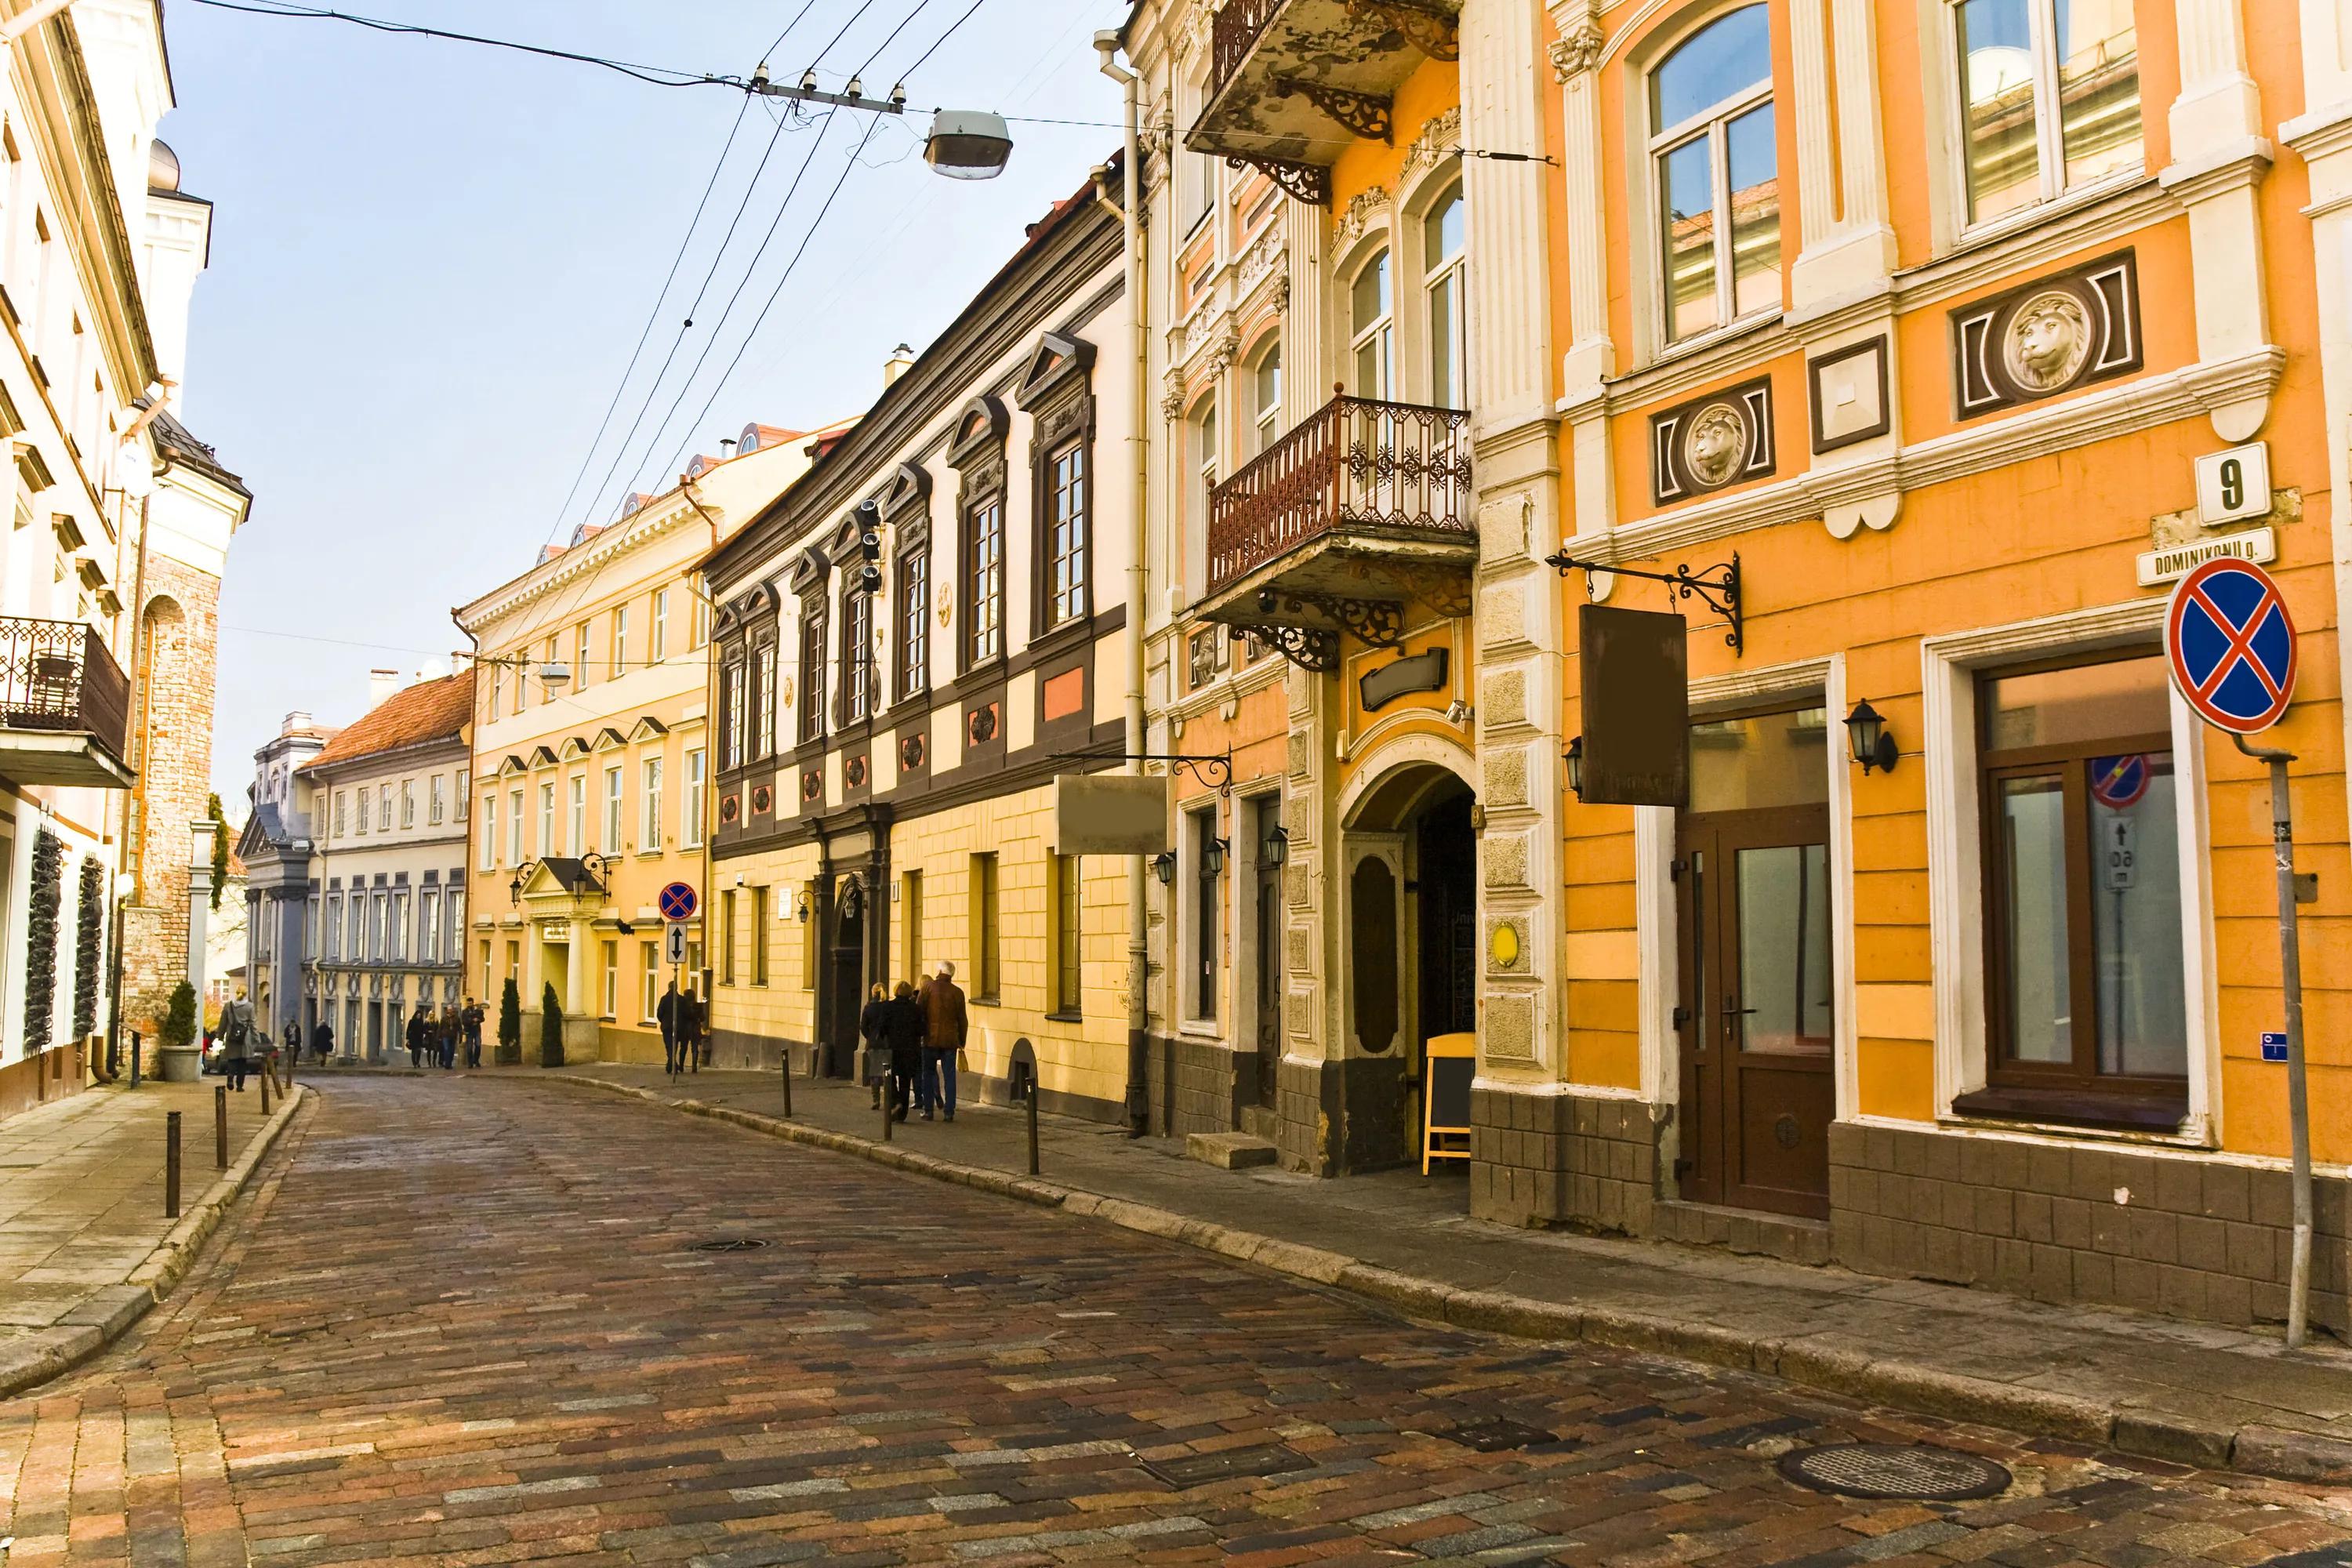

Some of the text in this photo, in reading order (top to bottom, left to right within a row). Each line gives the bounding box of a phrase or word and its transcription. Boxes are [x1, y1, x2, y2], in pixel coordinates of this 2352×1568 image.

[2220, 459, 2244, 510] 9
[2246, 541, 2258, 560] g.
[1474, 809, 1479, 824] 9
